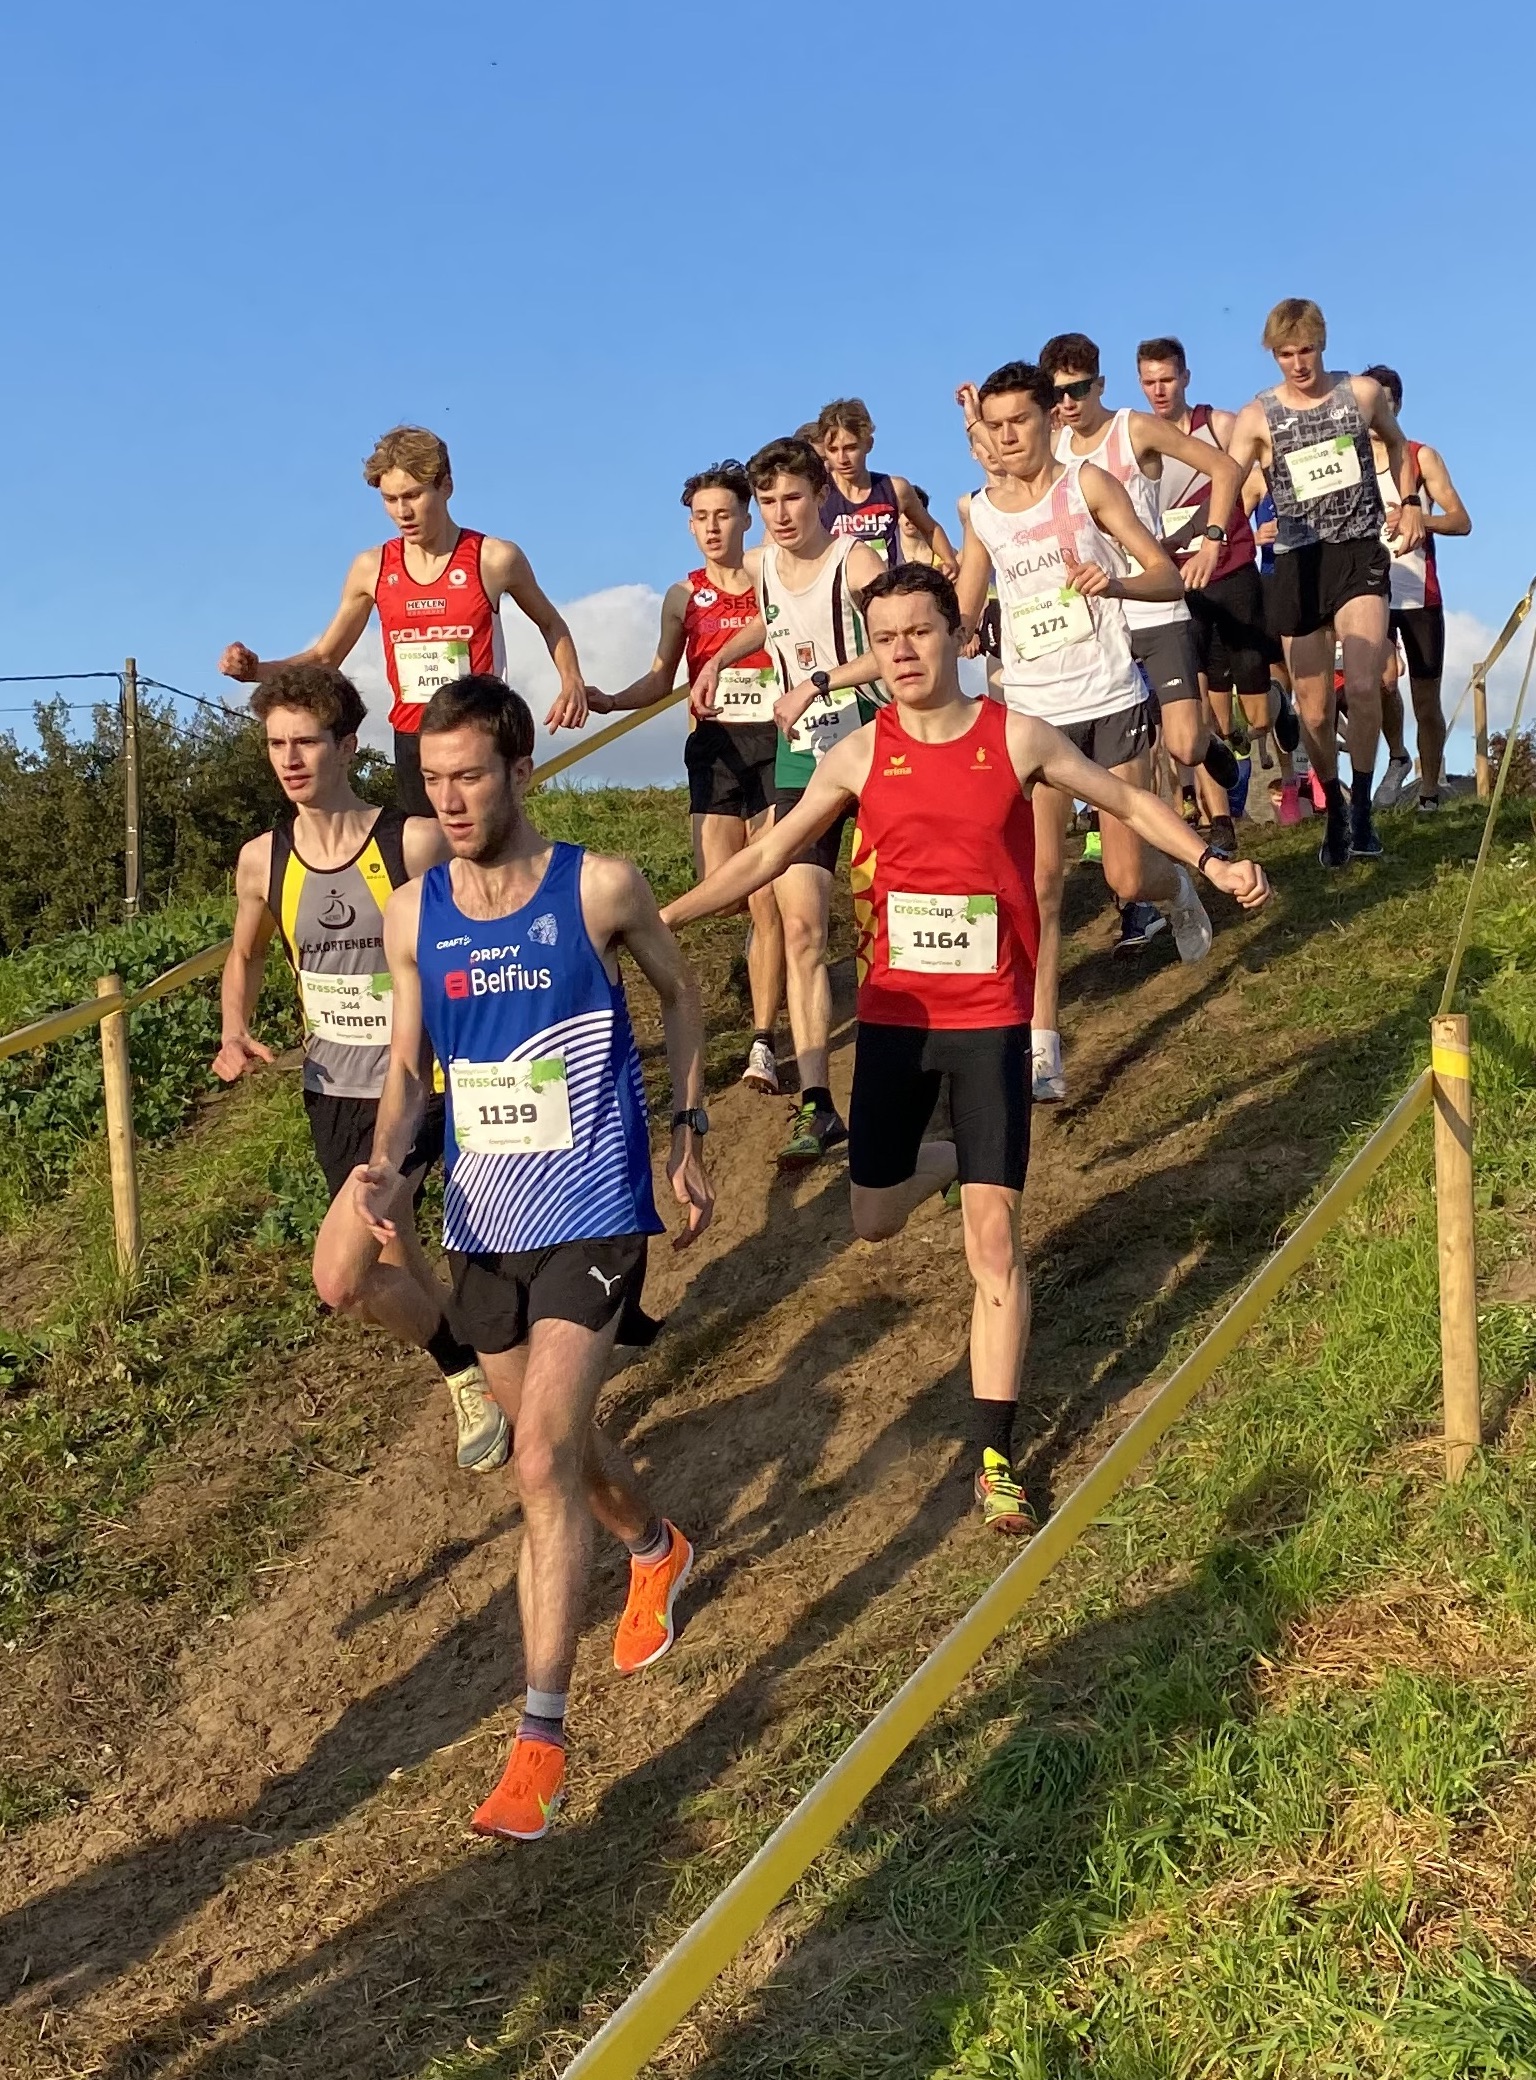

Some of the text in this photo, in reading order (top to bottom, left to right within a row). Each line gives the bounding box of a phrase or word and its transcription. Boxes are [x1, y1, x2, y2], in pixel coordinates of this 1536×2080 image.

[1308, 461, 1343, 482] 1141
[407, 600, 445, 609] HEYLEN
[389, 624, 474, 644] GOLAZO
[1030, 615, 1069, 638] 1171
[417, 675, 450, 687] Arne
[723, 692, 762, 705] 1170
[803, 711, 840, 730] 1143
[883, 767, 912, 777] erima
[436, 937, 464, 950] CRAFT
[913, 931, 970, 949] 1164
[471, 963, 552, 996] Belfius
[340, 1001, 360, 1010] 344
[320, 1010, 387, 1027] Tiemen
[478, 1103, 538, 1125] 1139
